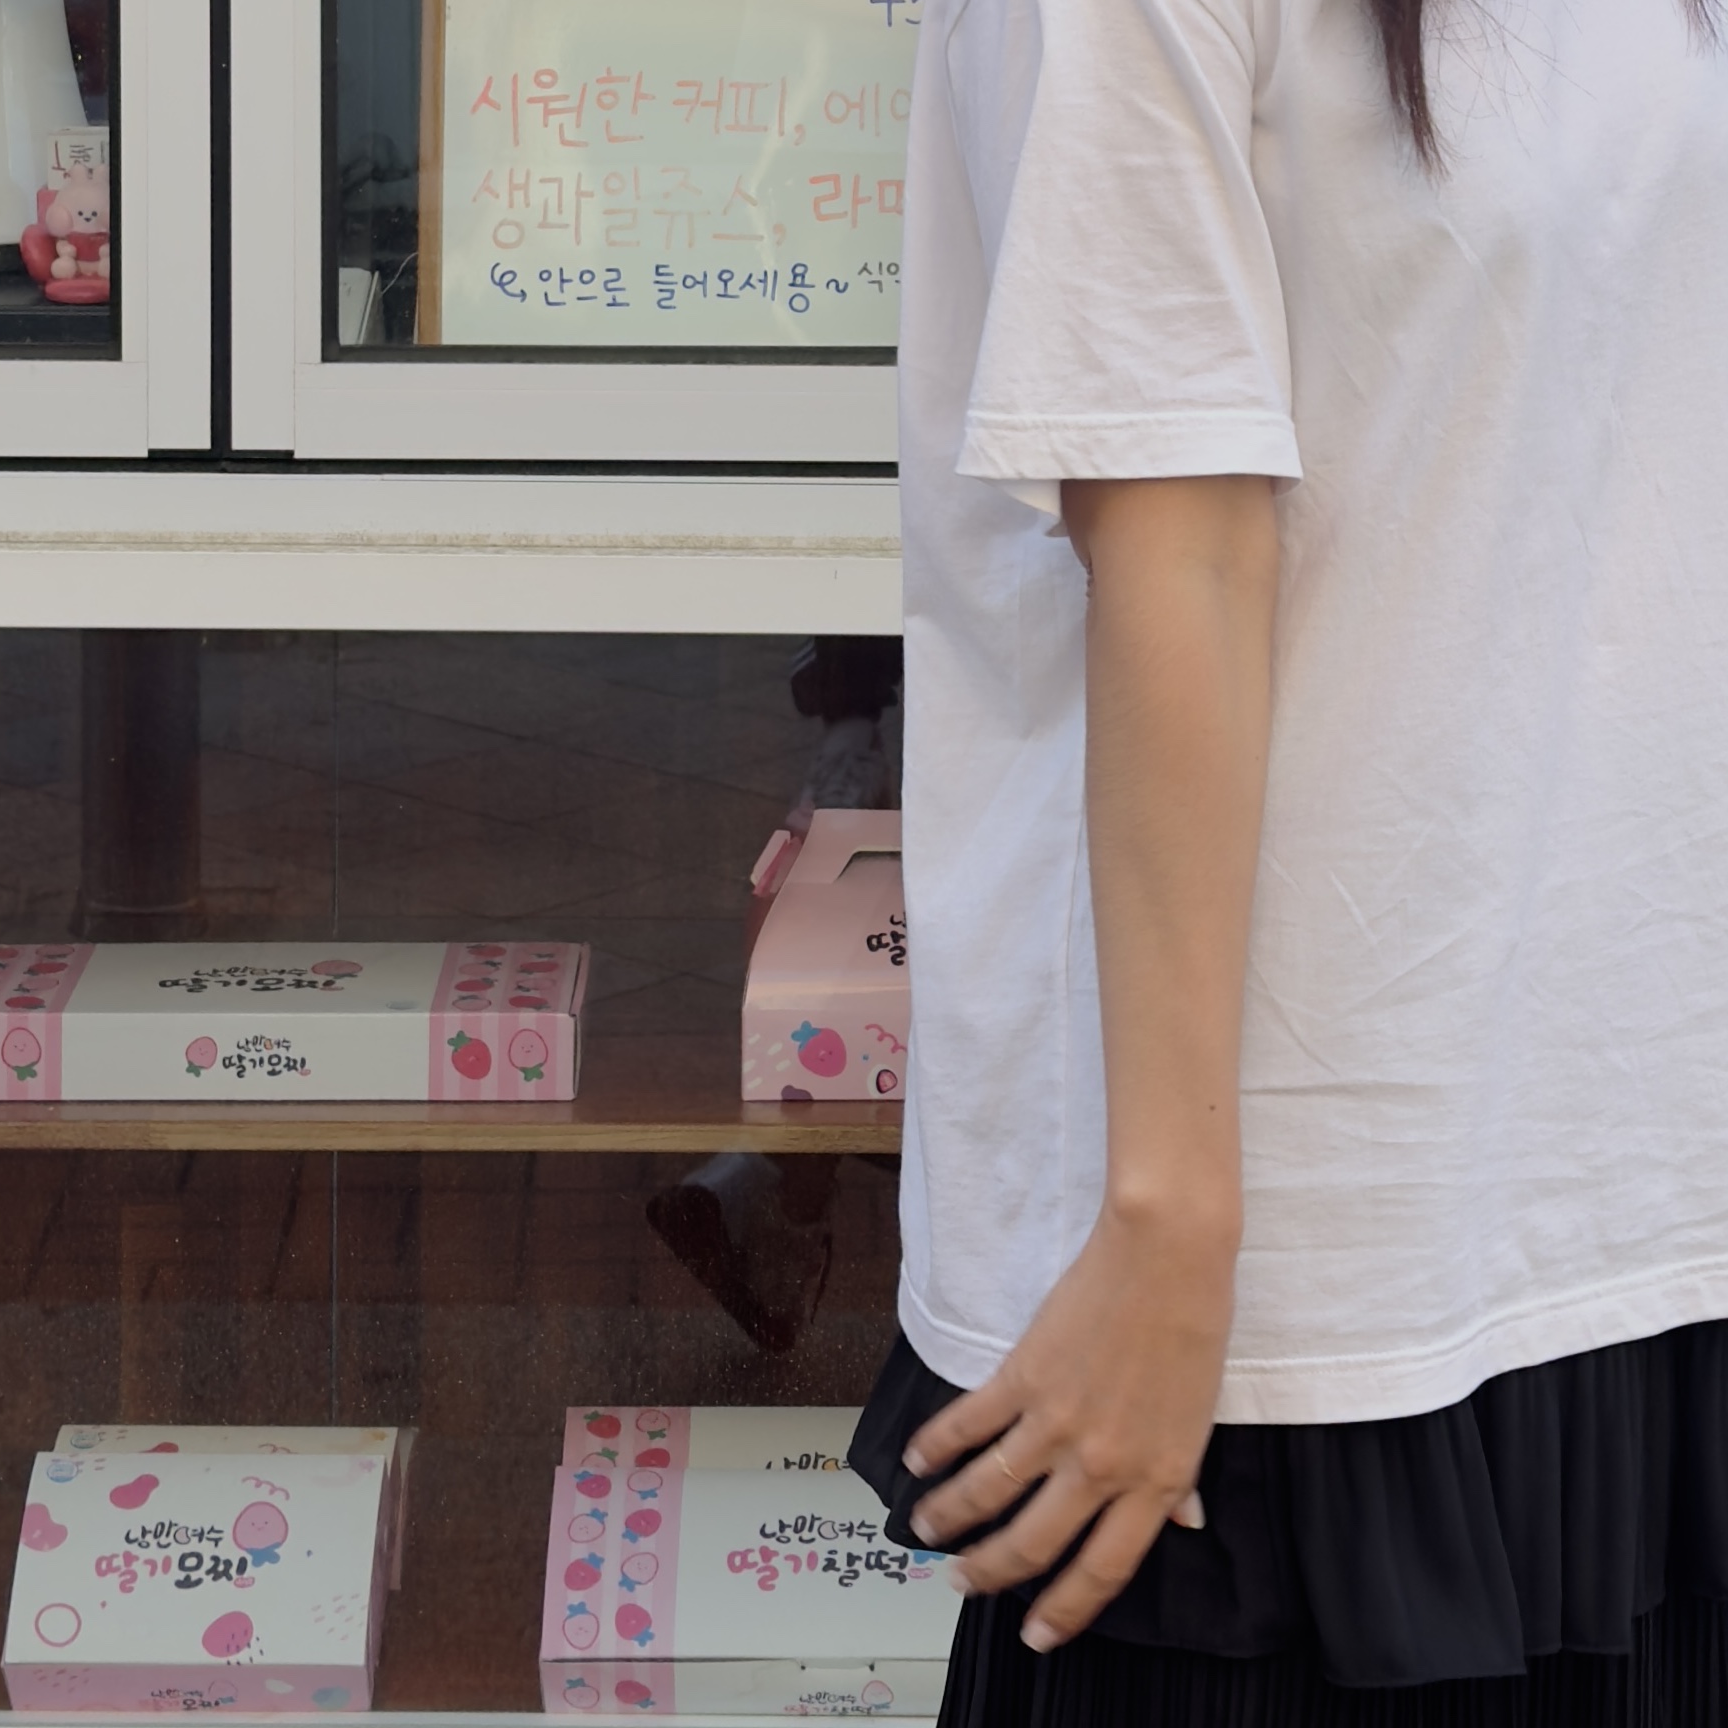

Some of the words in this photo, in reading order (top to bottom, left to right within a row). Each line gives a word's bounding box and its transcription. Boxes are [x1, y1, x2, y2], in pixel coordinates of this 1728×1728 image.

[470, 67, 656, 148] 시원한
[673, 76, 806, 147] 커피,
[539, 266, 631, 308] 안으로
